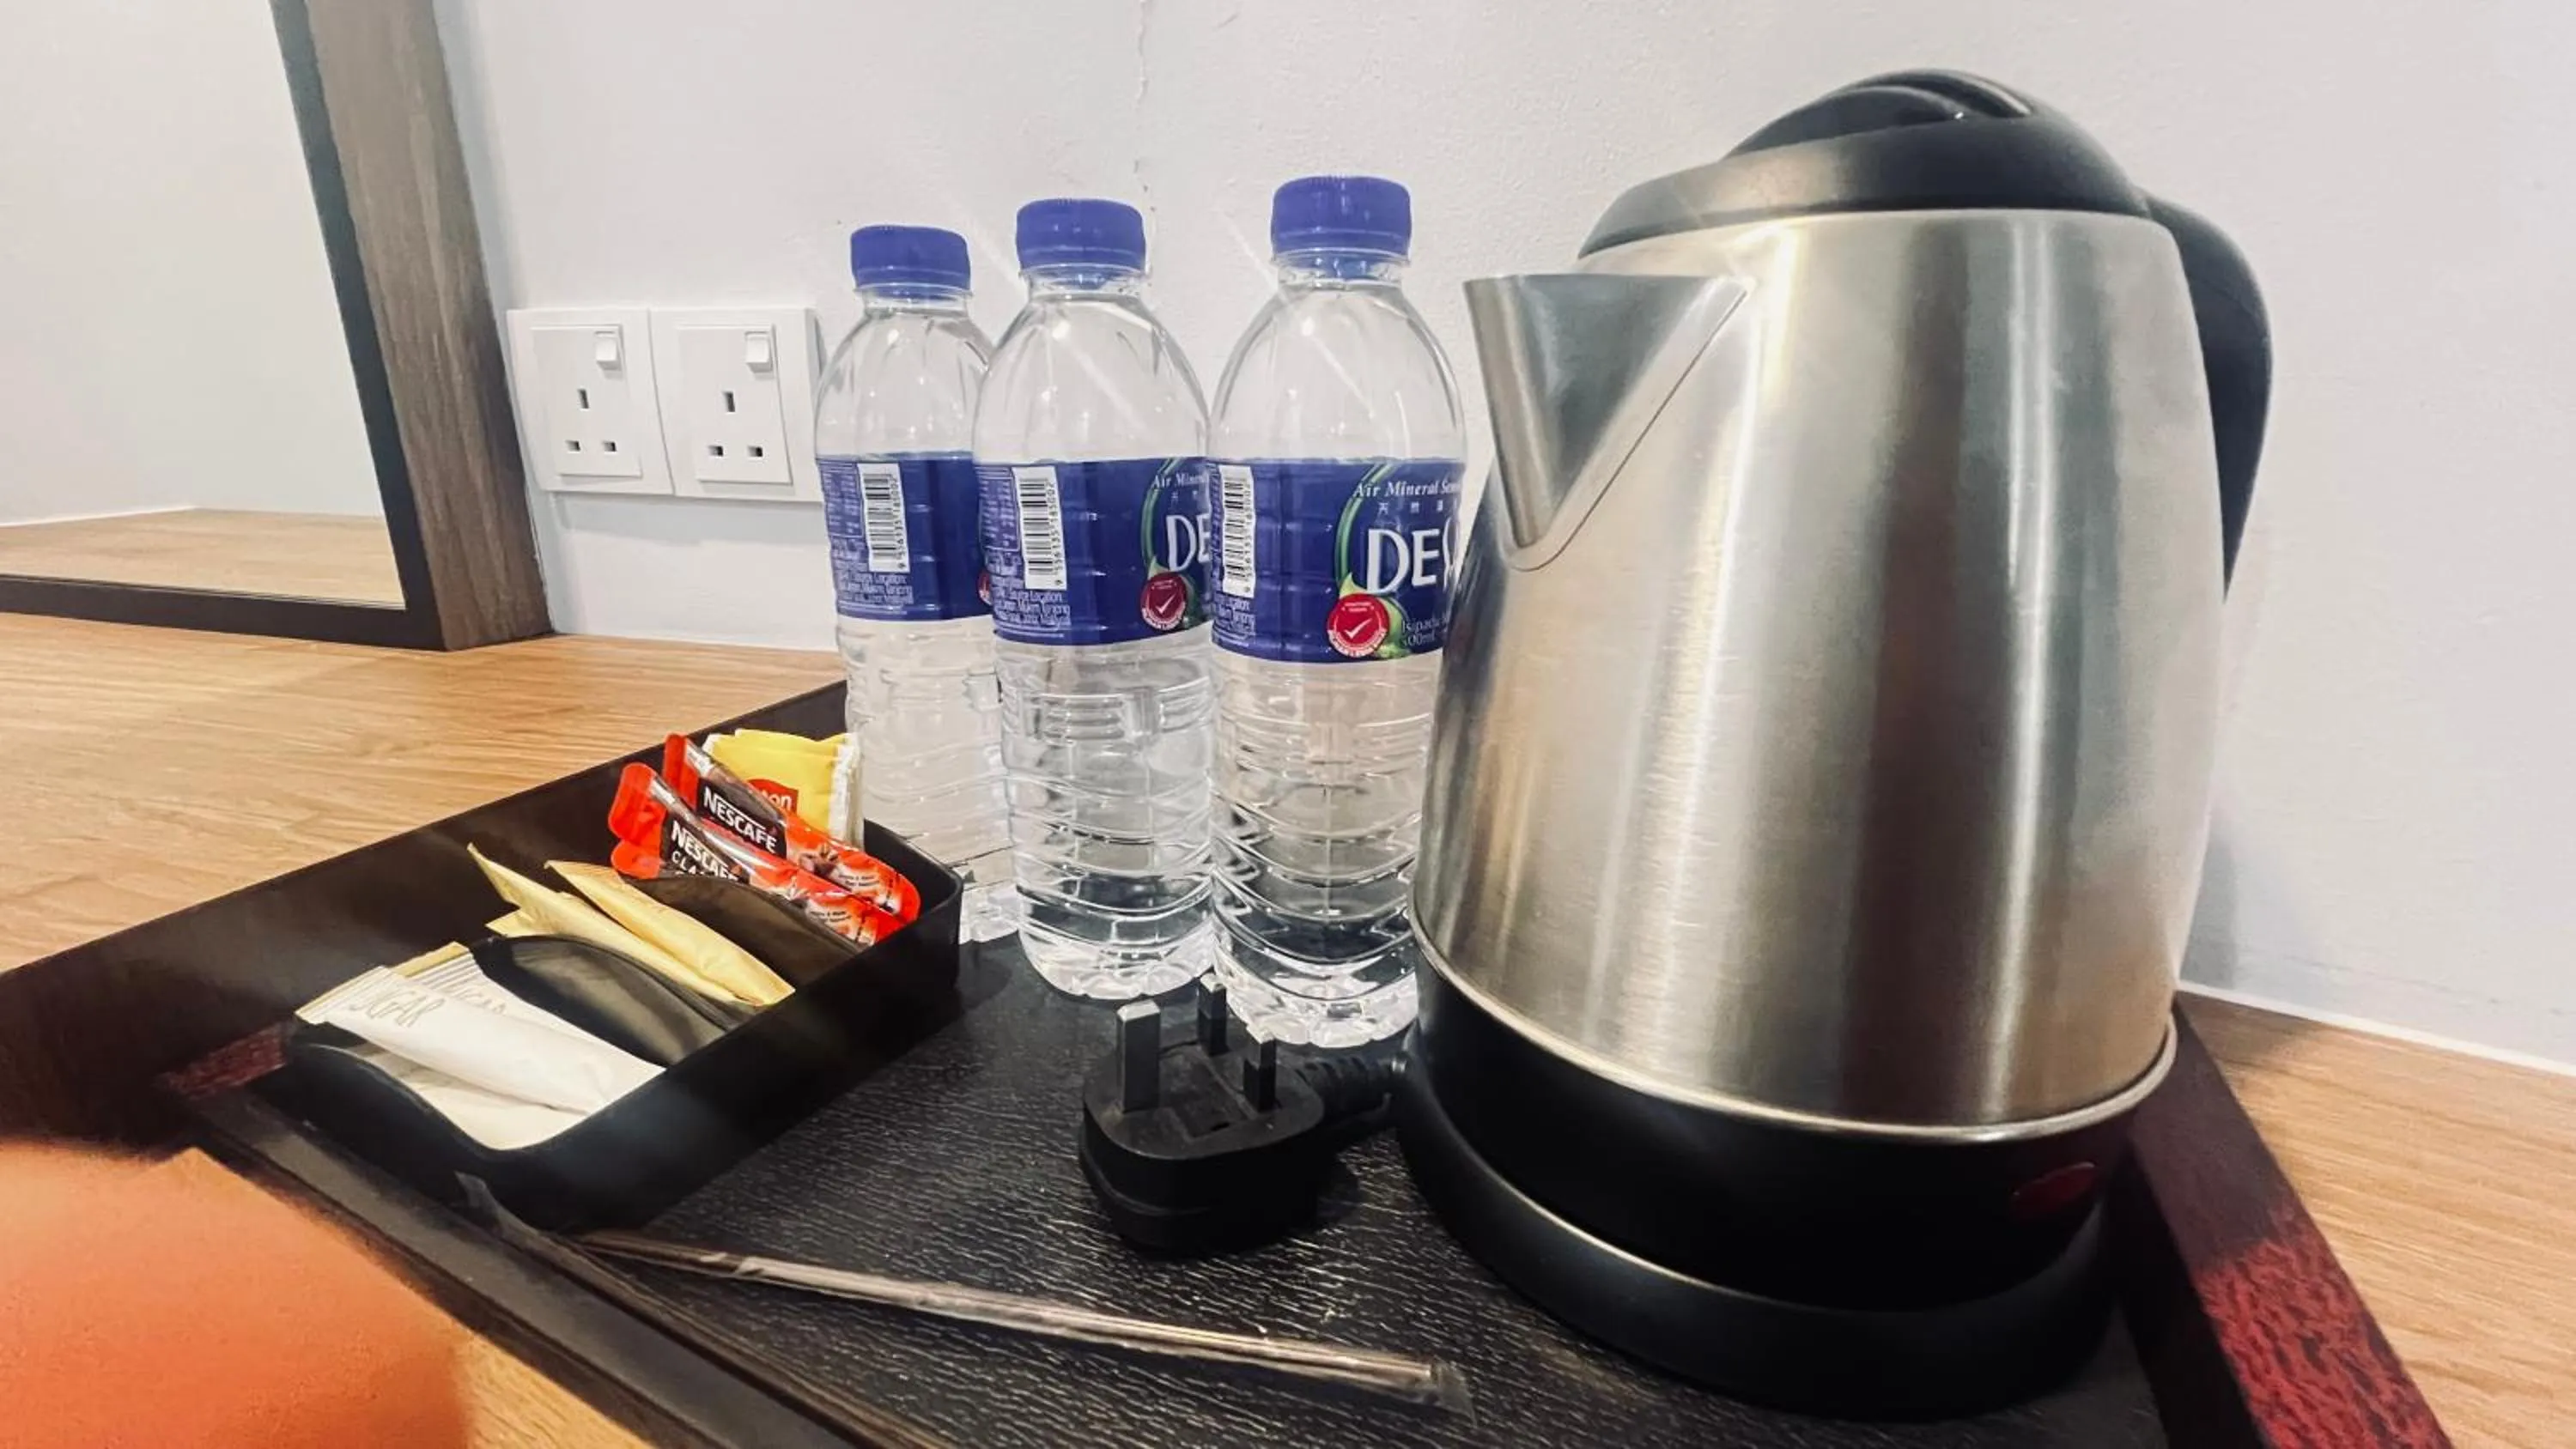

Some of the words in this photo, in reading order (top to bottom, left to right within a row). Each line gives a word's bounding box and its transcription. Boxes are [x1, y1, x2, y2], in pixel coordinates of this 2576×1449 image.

[1151, 475, 1171, 488] Air
[1353, 483, 1380, 497] Air
[1384, 481, 1439, 496] Mineral
